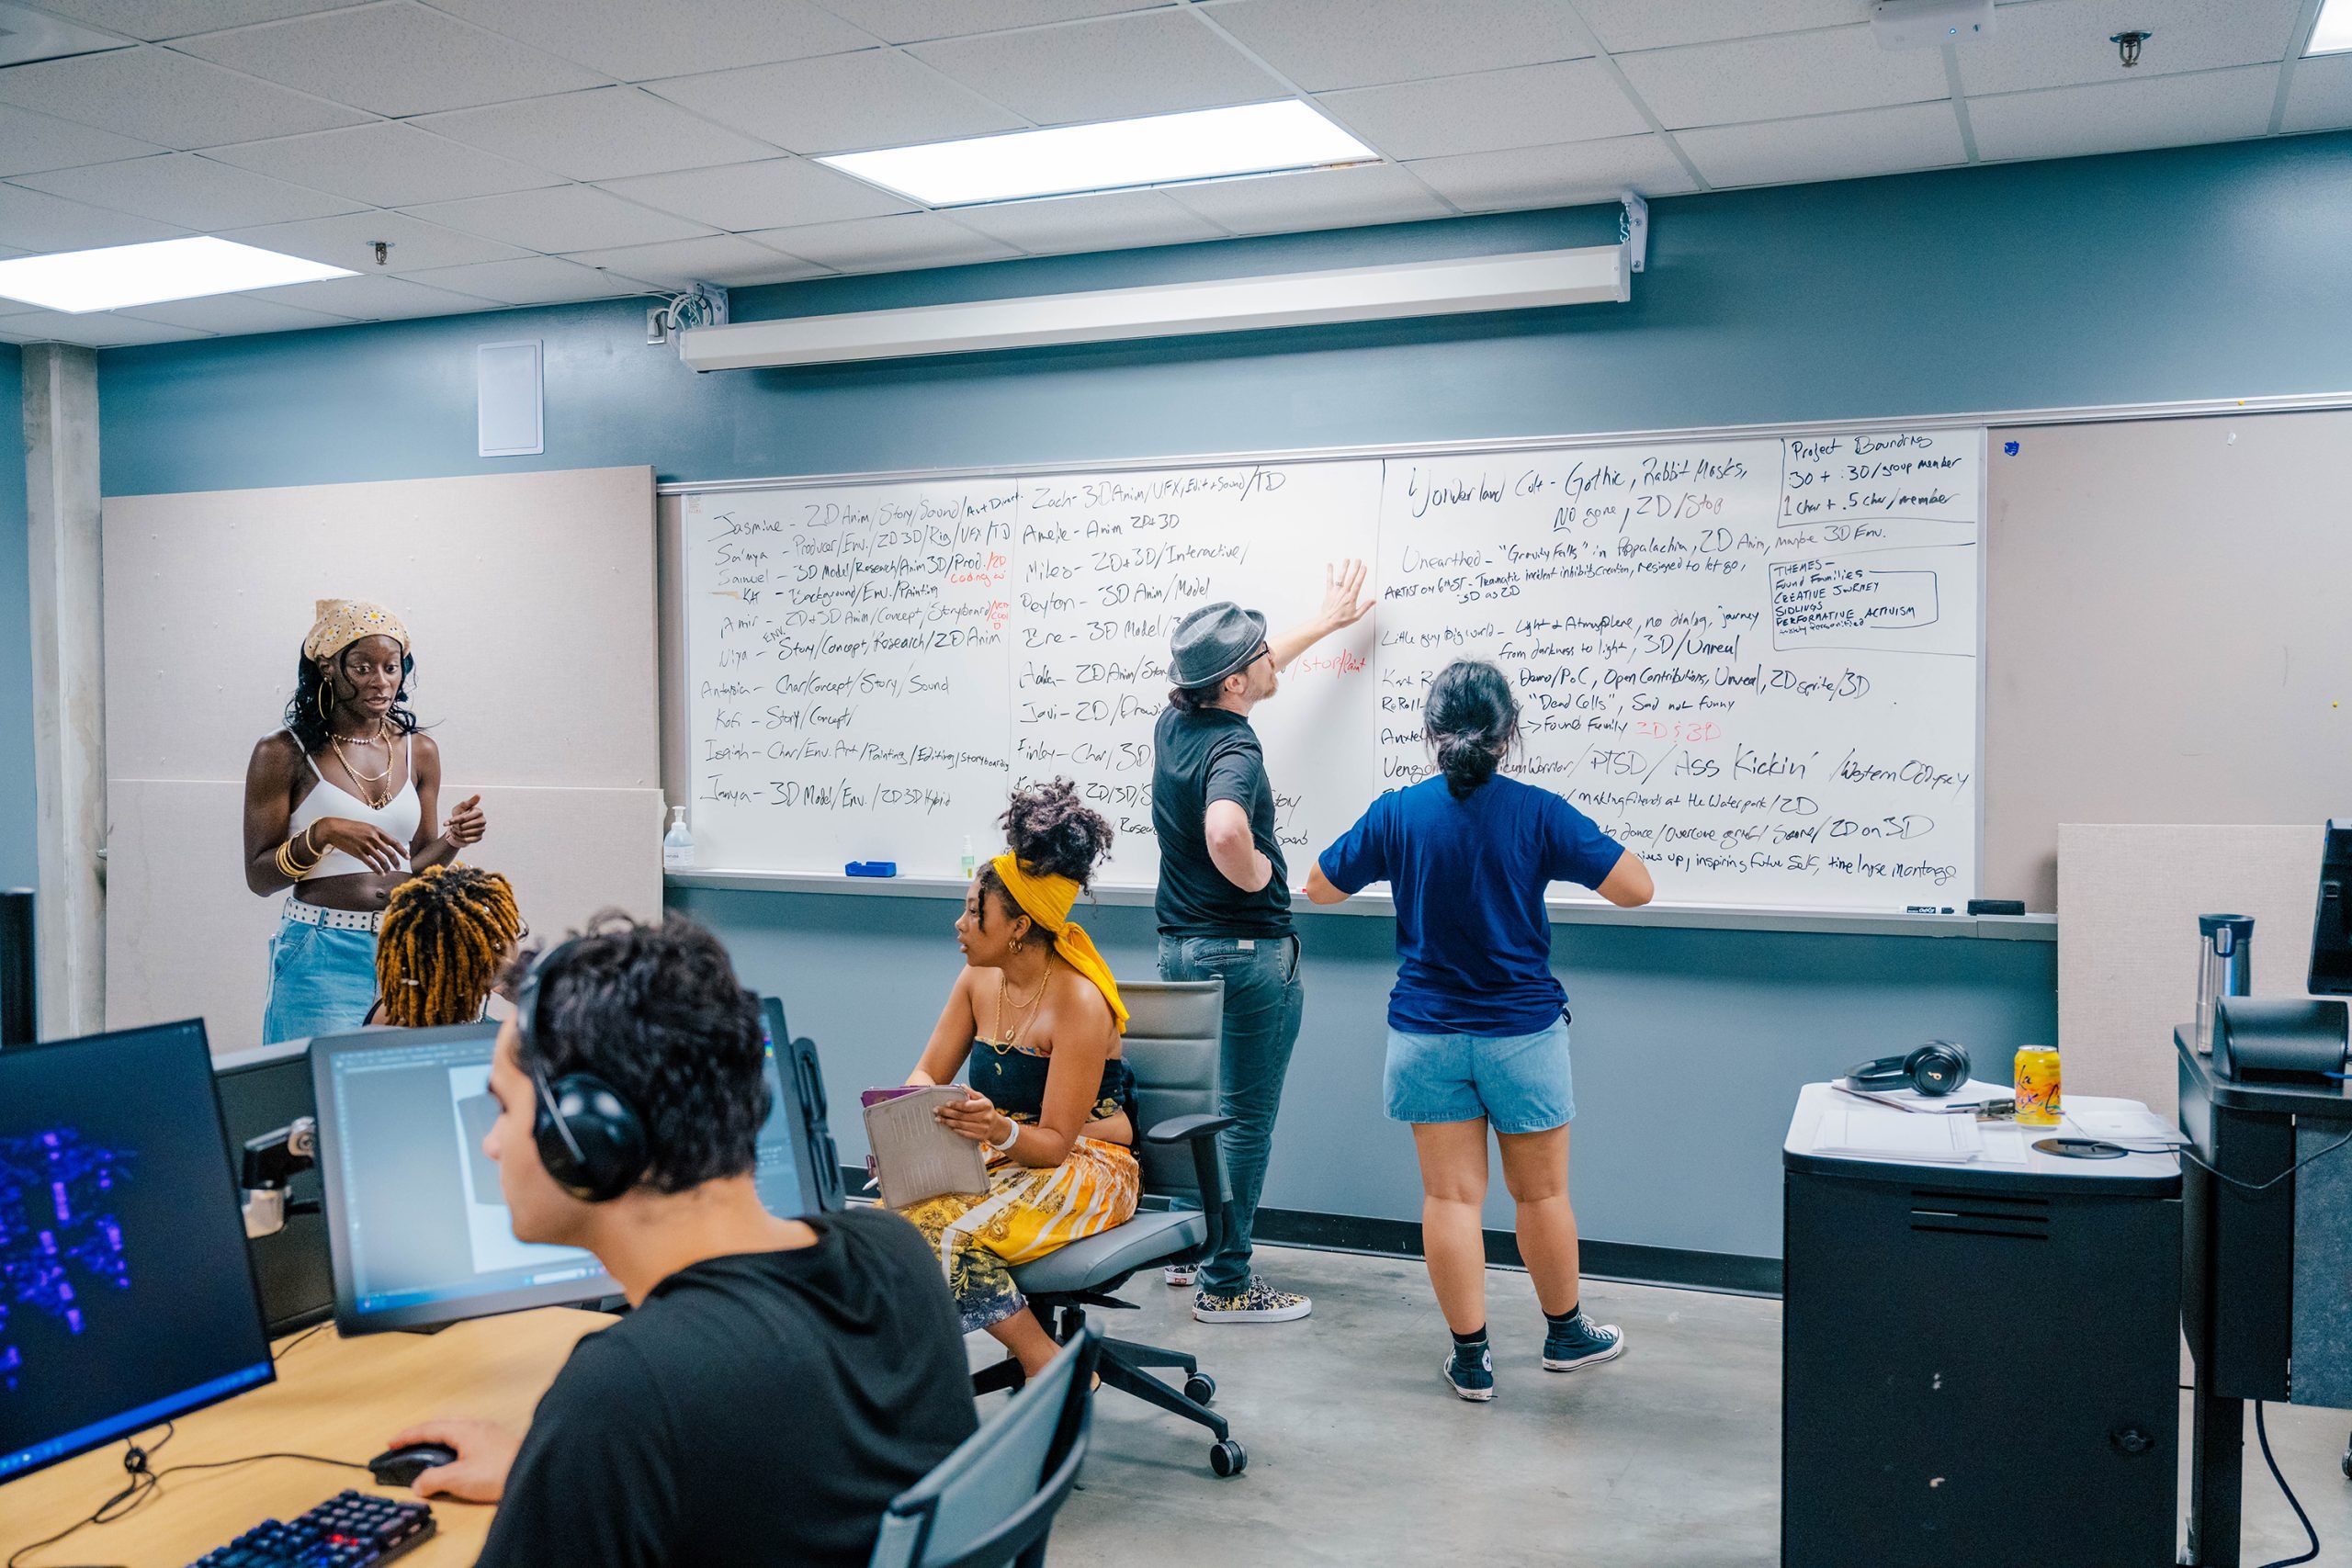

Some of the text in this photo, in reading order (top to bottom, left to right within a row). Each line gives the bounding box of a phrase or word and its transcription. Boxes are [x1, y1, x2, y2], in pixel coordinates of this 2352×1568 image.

[1792, 437, 1843, 462] Project
[1685, 559, 1701, 573] to
[1581, 642, 1593, 653] to
